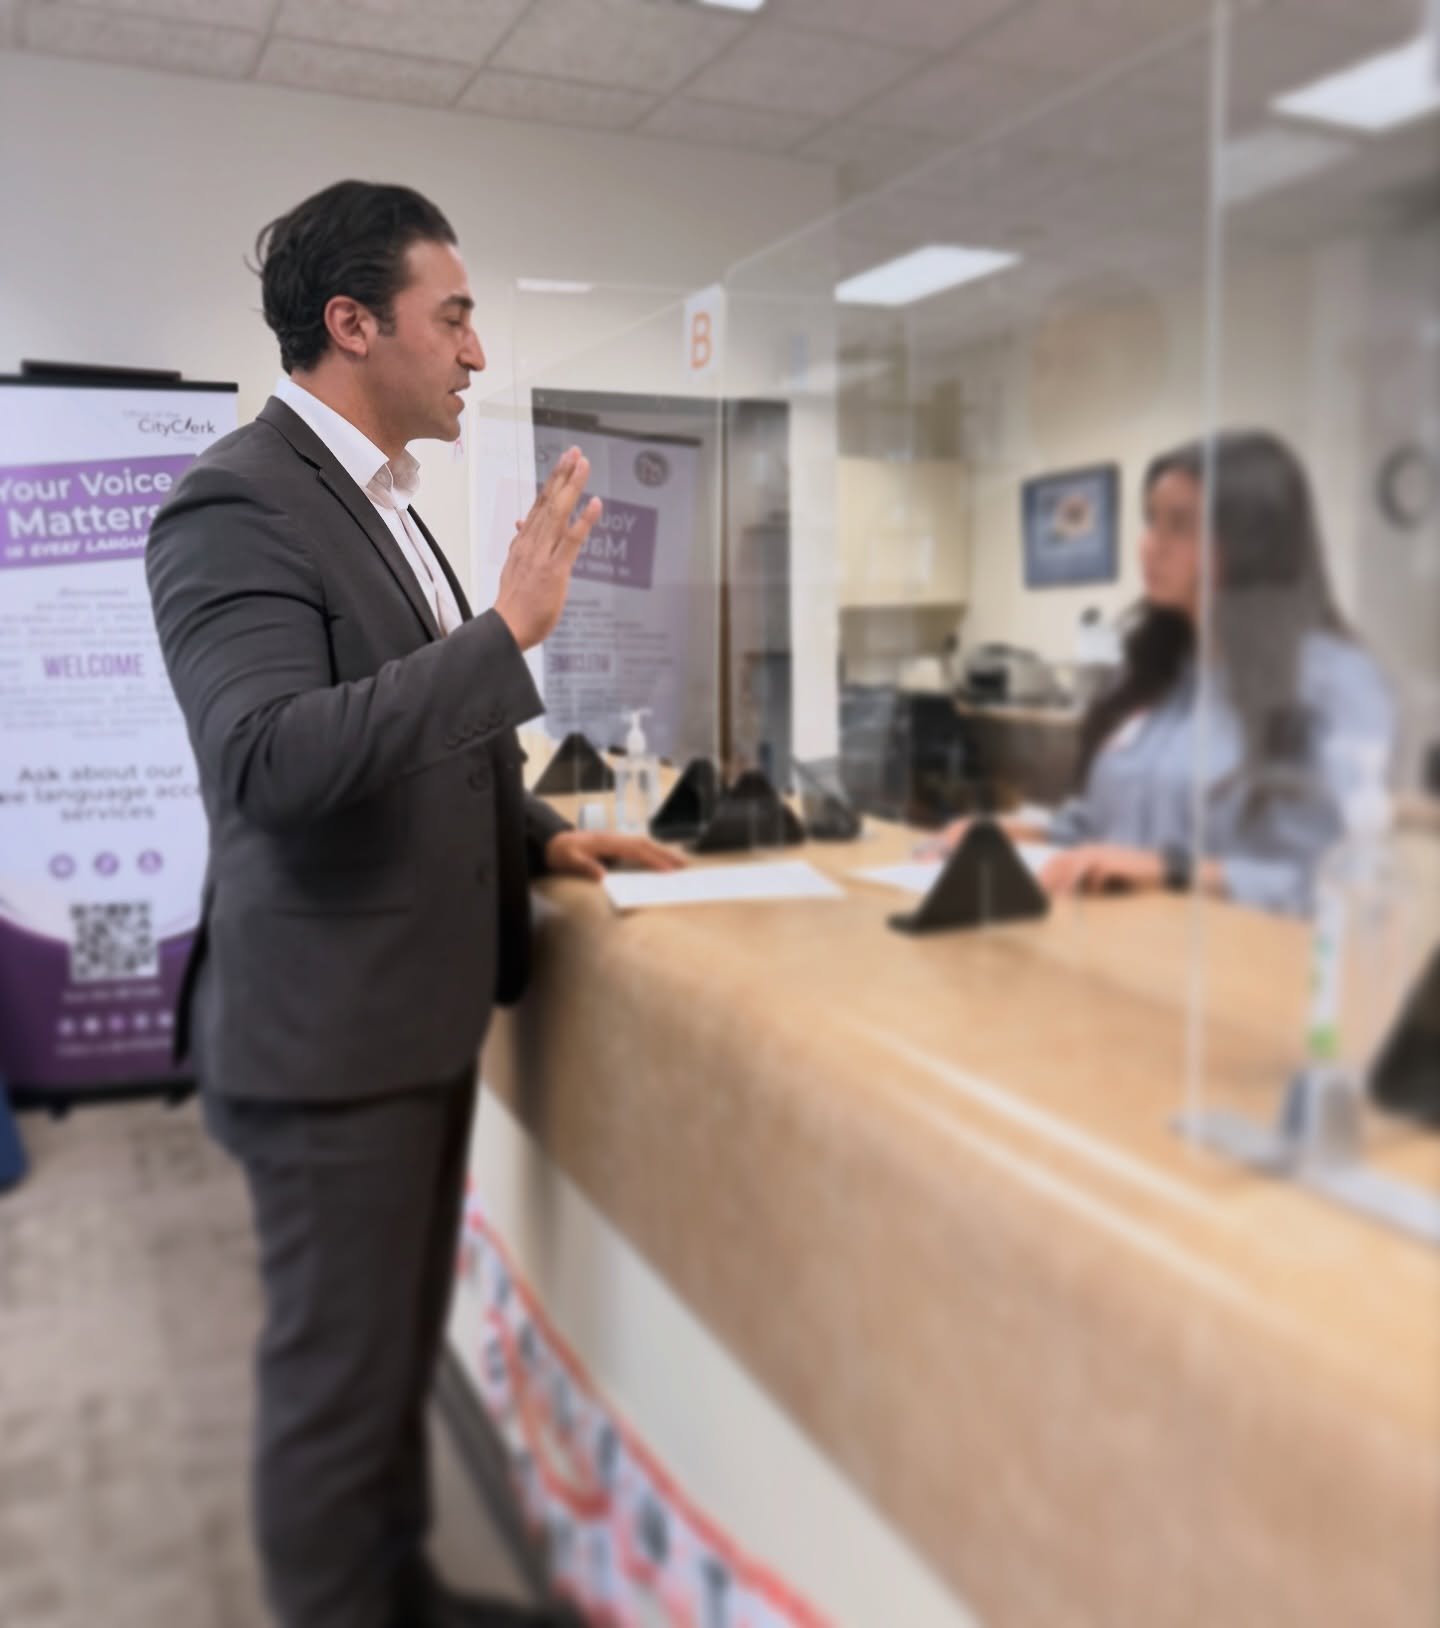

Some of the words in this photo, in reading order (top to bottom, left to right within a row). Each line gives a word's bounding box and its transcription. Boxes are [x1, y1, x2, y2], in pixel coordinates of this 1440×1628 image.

[690, 311, 714, 371] B
[79, 467, 173, 497] Voice
[43, 654, 144, 679] WELCOME
[19, 765, 60, 782] Ask
[71, 764, 137, 782] about
[145, 764, 184, 780] our
[34, 786, 148, 808] language
[61, 805, 156, 822] services
